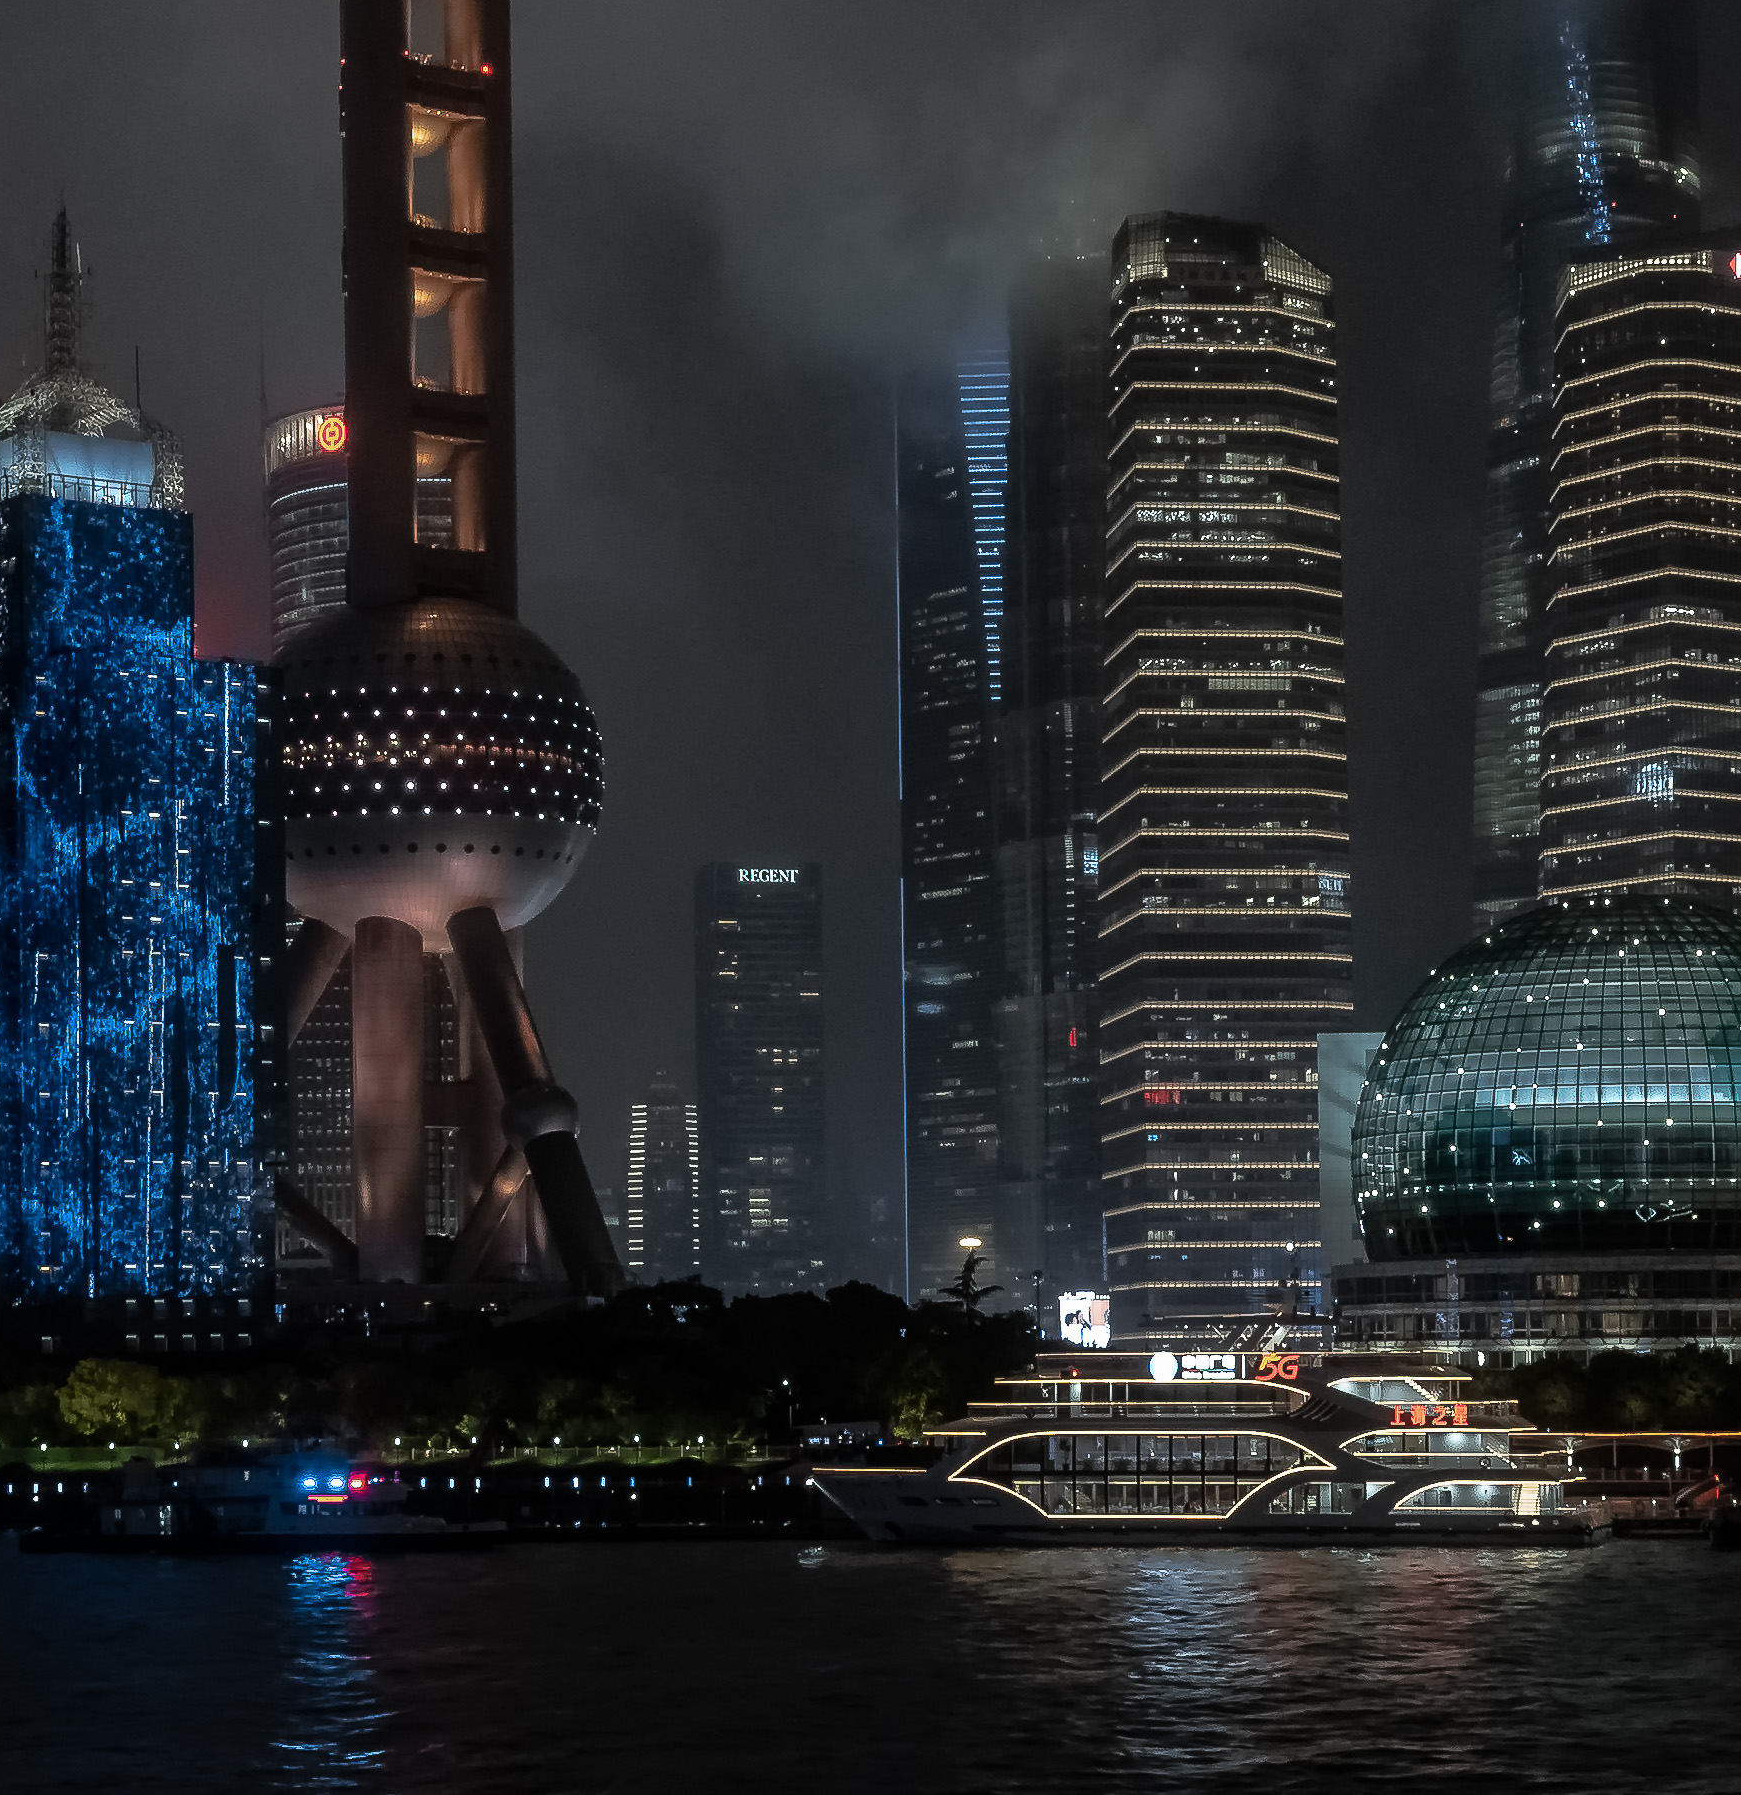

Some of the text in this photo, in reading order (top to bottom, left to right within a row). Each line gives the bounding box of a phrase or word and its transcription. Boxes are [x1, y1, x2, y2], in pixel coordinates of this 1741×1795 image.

[737, 868, 799, 883] REGENT
[1254, 1352, 1301, 1381] 5G
[1390, 1403, 1469, 1427] 上海之星
